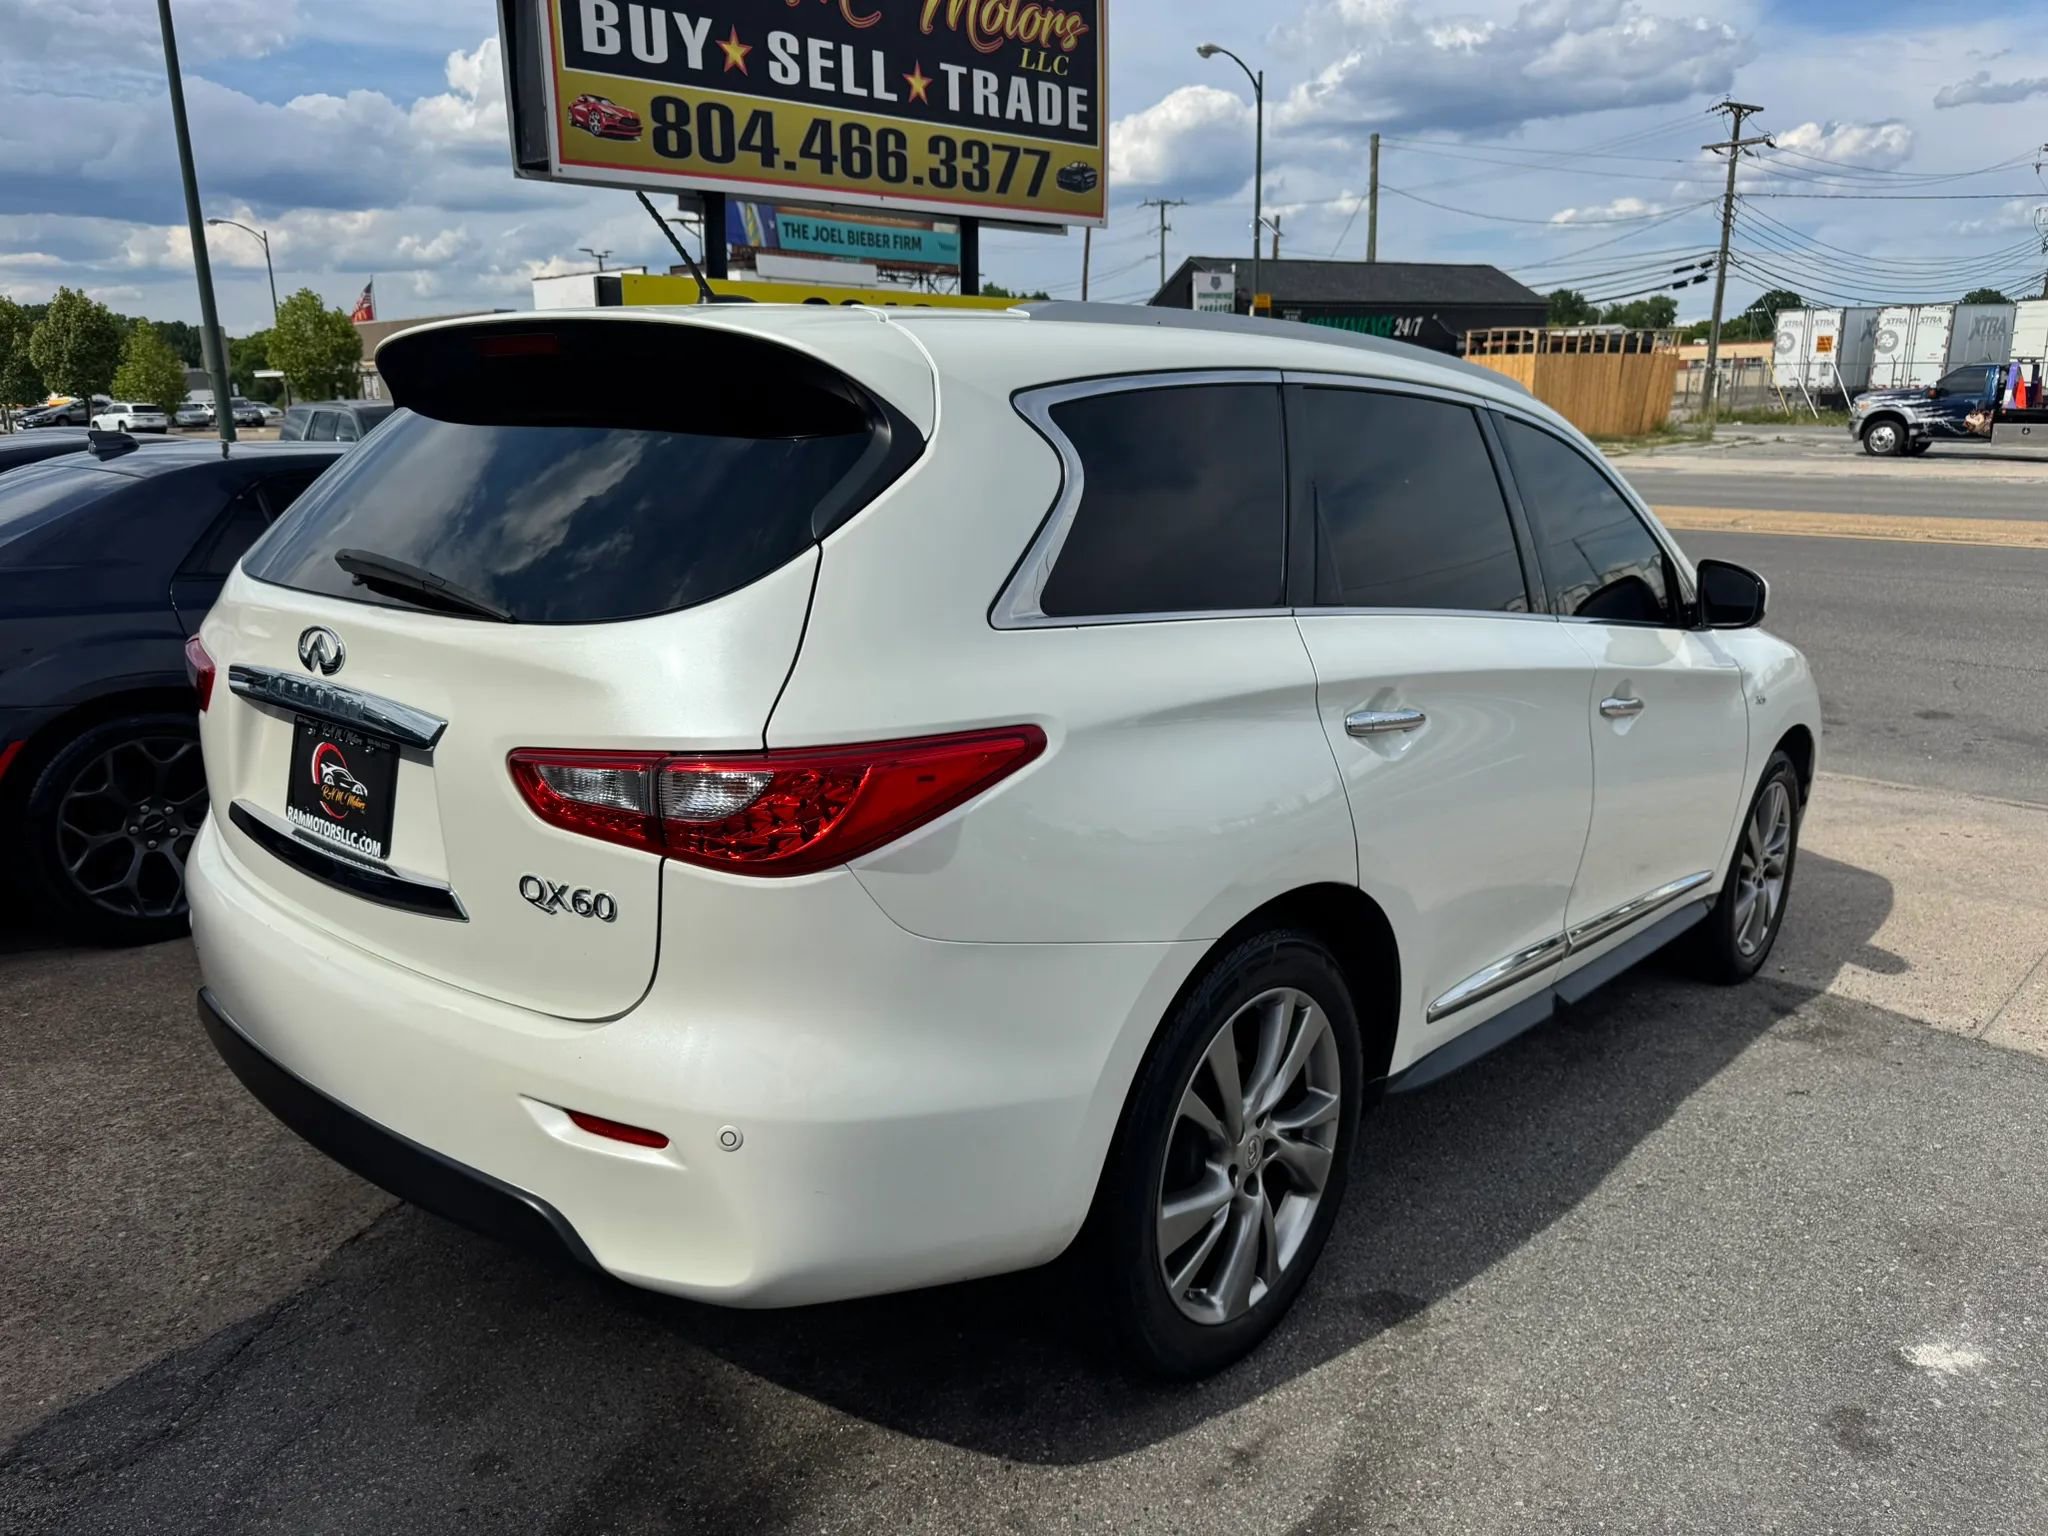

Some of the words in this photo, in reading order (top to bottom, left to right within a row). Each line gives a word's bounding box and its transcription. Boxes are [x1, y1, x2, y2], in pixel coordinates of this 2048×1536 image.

[580, 0, 712, 70] BUY
[767, 31, 898, 102] SELL
[939, 62, 1088, 131] TRADE
[1018, 47, 1070, 76] LLC
[650, 95, 1051, 197] 804.466.3377
[783, 221, 810, 241] THE
[812, 226, 844, 245] JOEL
[848, 229, 890, 249] BIEBER
[893, 234, 922, 251] FIRM
[1394, 315, 1423, 337] 24/7
[1885, 317, 1908, 327] XTRA
[1918, 315, 1942, 326] XTRA
[1968, 314, 2006, 340] XTRA
[518, 873, 617, 922] QX60
